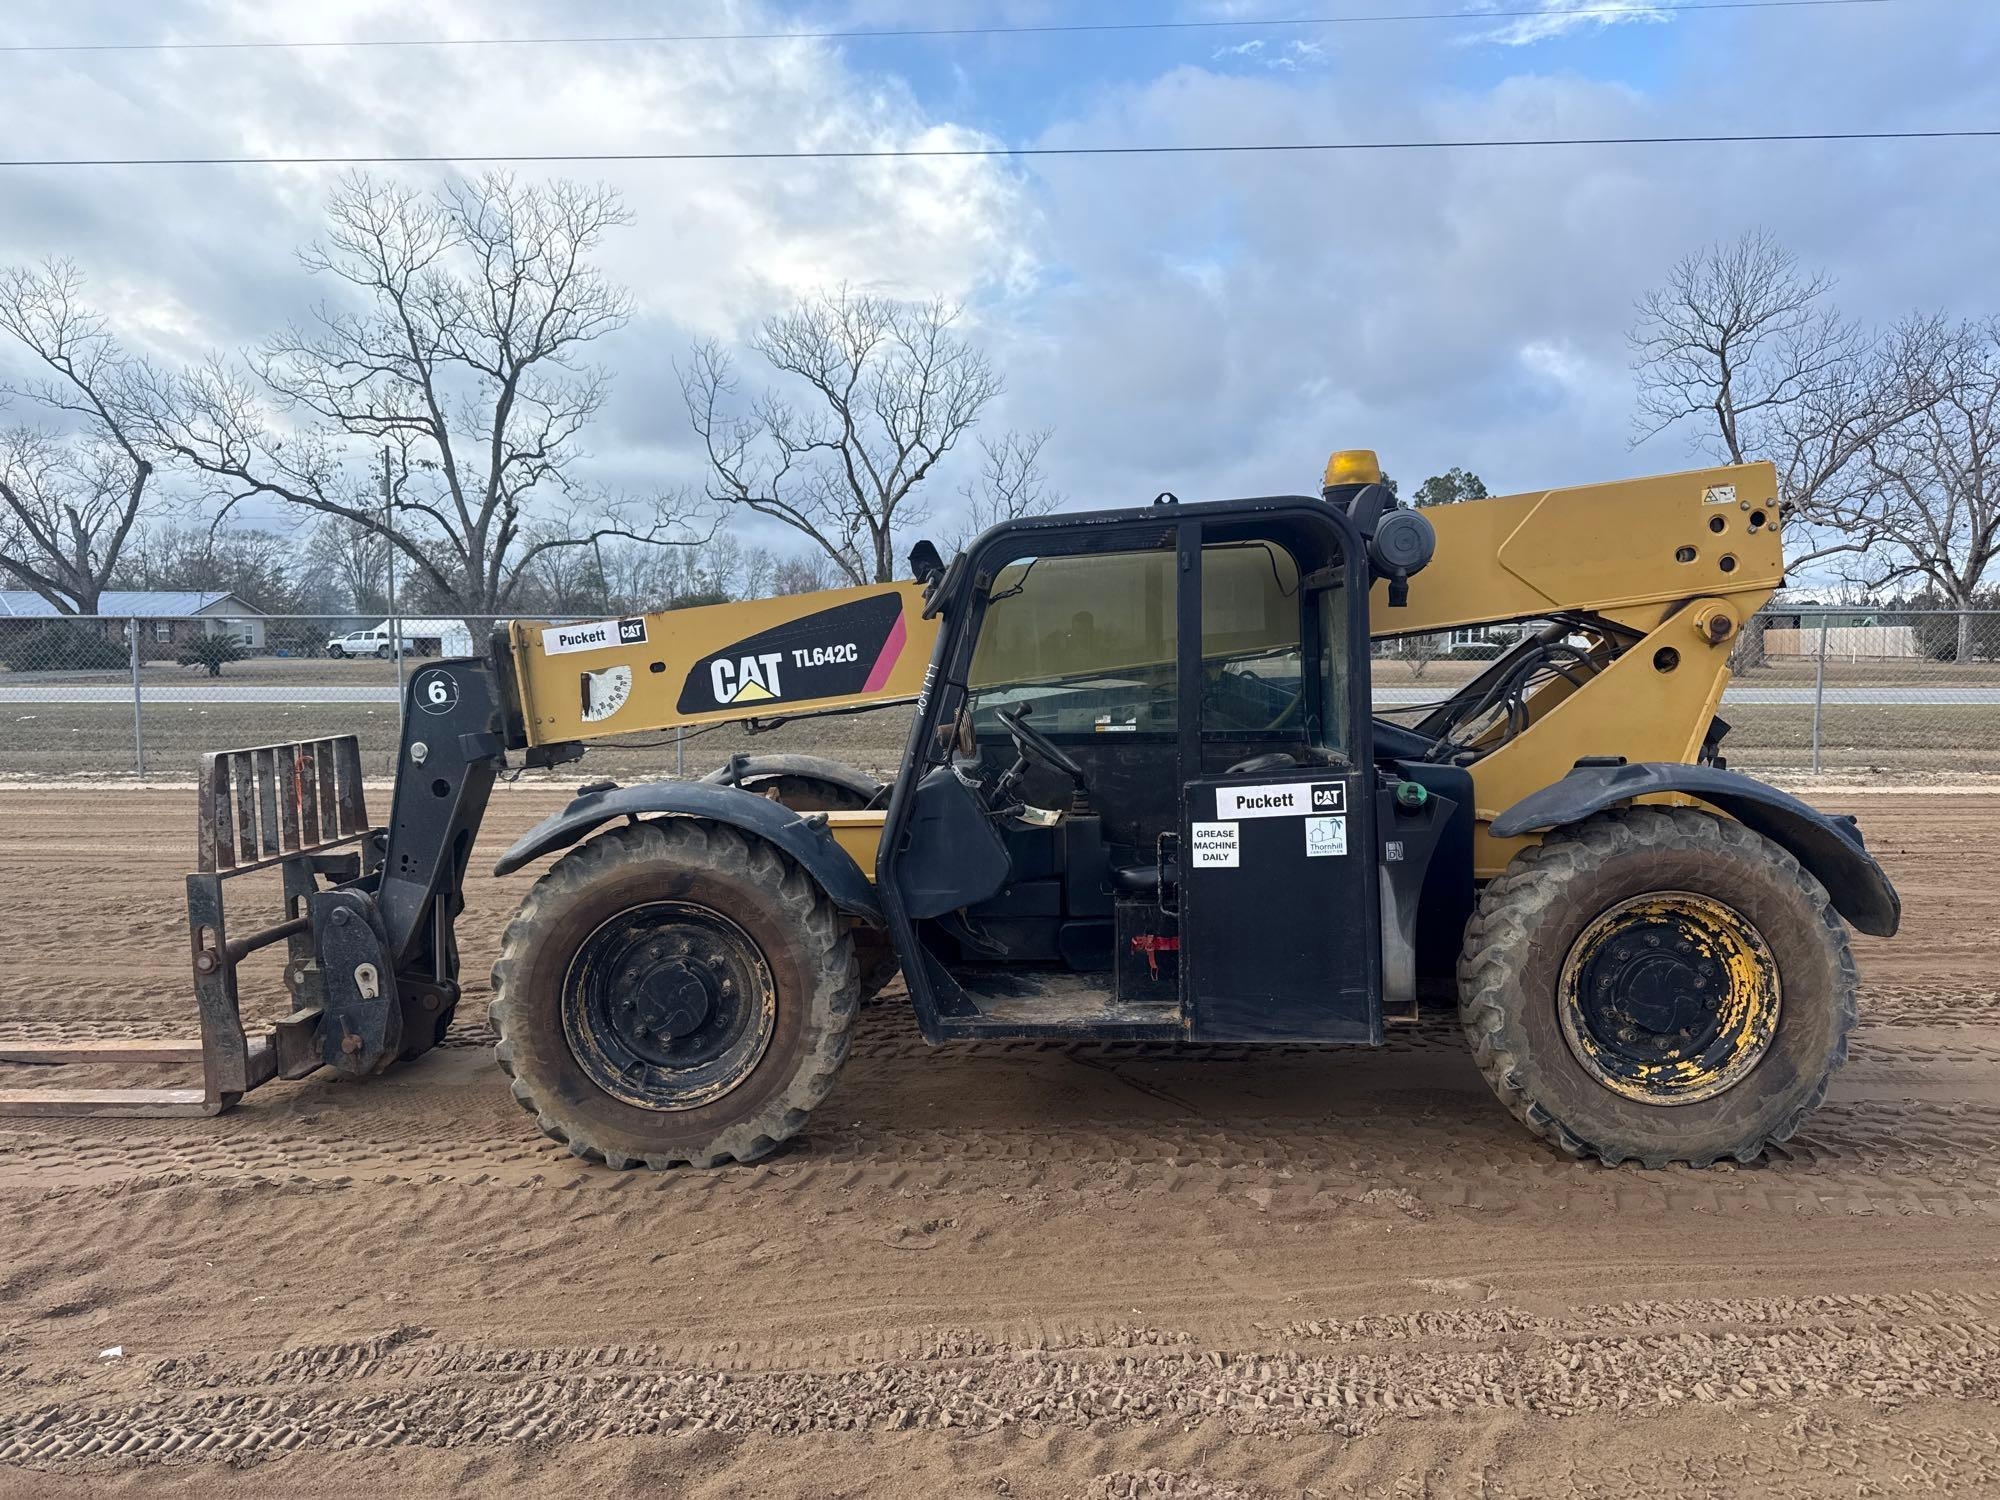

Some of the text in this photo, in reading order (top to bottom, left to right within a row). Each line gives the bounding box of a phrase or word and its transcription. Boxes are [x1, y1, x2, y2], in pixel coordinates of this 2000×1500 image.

[559, 622, 643, 647] Puckett CAT
[792, 643, 858, 668] TL642C
[710, 652, 782, 704] CAT
[428, 681, 447, 703] 6
[1236, 789, 1341, 810] Puckett CAT
[1196, 830, 1234, 838] GREASE
[1193, 841, 1238, 850] MACHINE
[1310, 842, 1343, 851] Thornhill
[1202, 853, 1230, 861] DAILY
